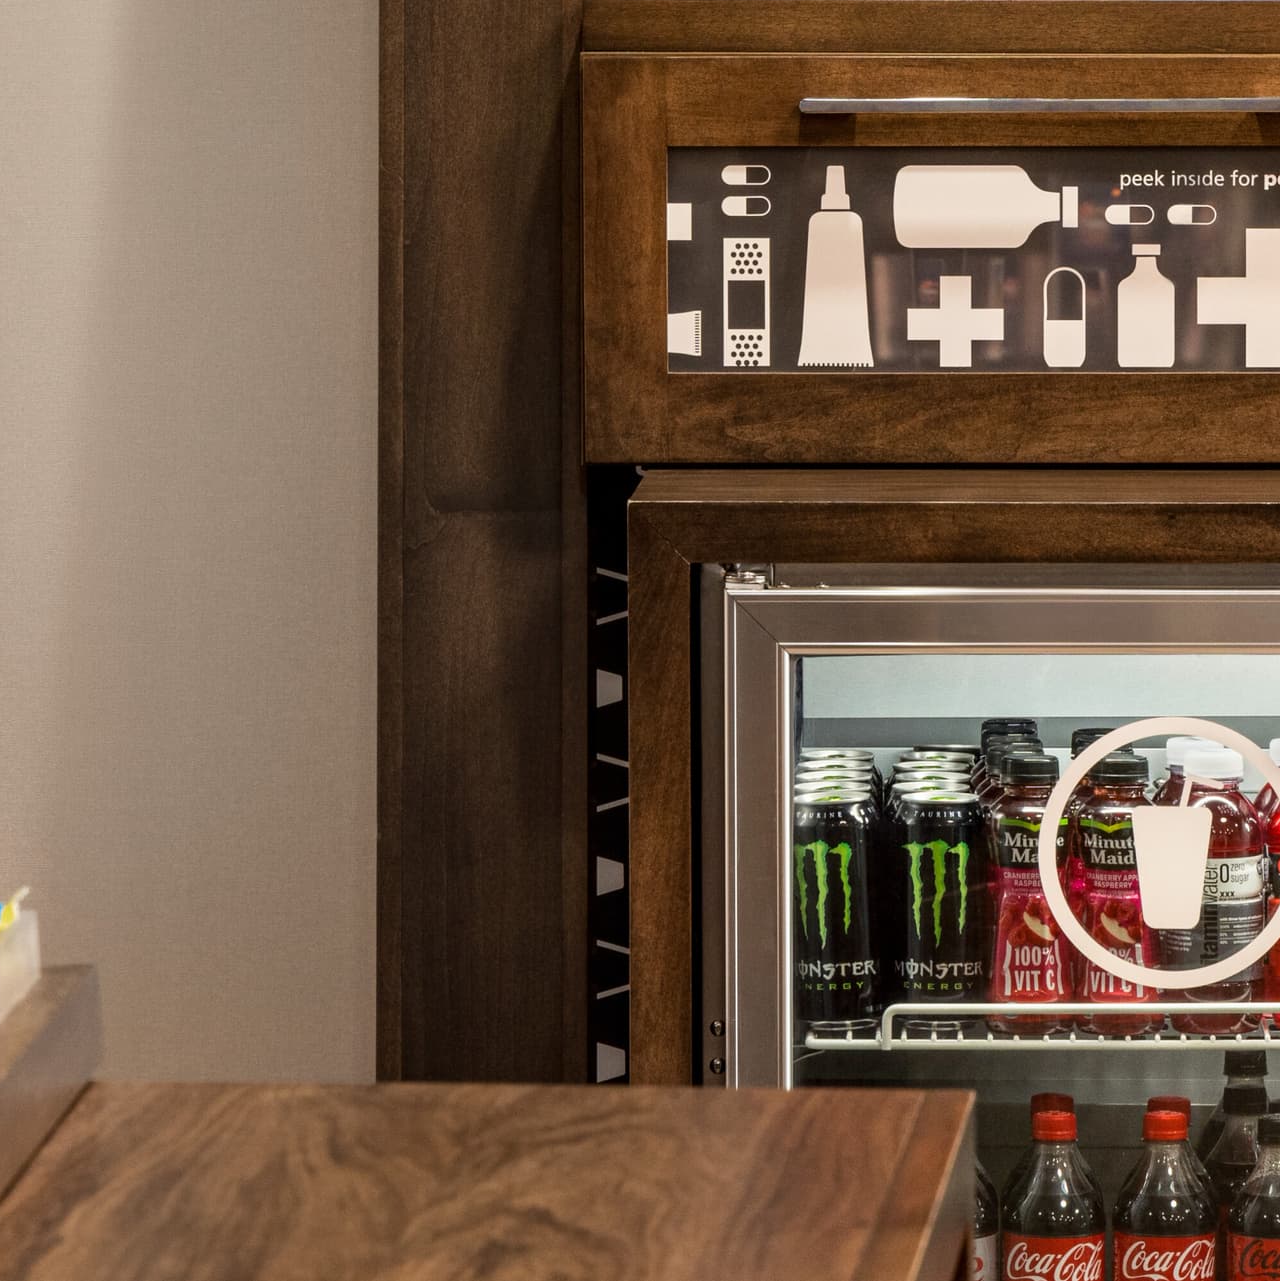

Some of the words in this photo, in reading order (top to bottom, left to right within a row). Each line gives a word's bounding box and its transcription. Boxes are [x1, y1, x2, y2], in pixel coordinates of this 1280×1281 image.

[1120, 170, 1165, 190] peek
[1171, 170, 1225, 186] inside
[1230, 170, 1259, 186] for
[1090, 849, 1136, 865] Maid
[1094, 880, 1133, 889] RASPBERRY
[1014, 945, 1055, 967] 100%
[894, 958, 984, 980] MONSTER
[804, 981, 865, 991] NERGY
[903, 981, 974, 991] ENERGY
[1014, 970, 1041, 992] VIT
[1046, 969, 1055, 991] C
